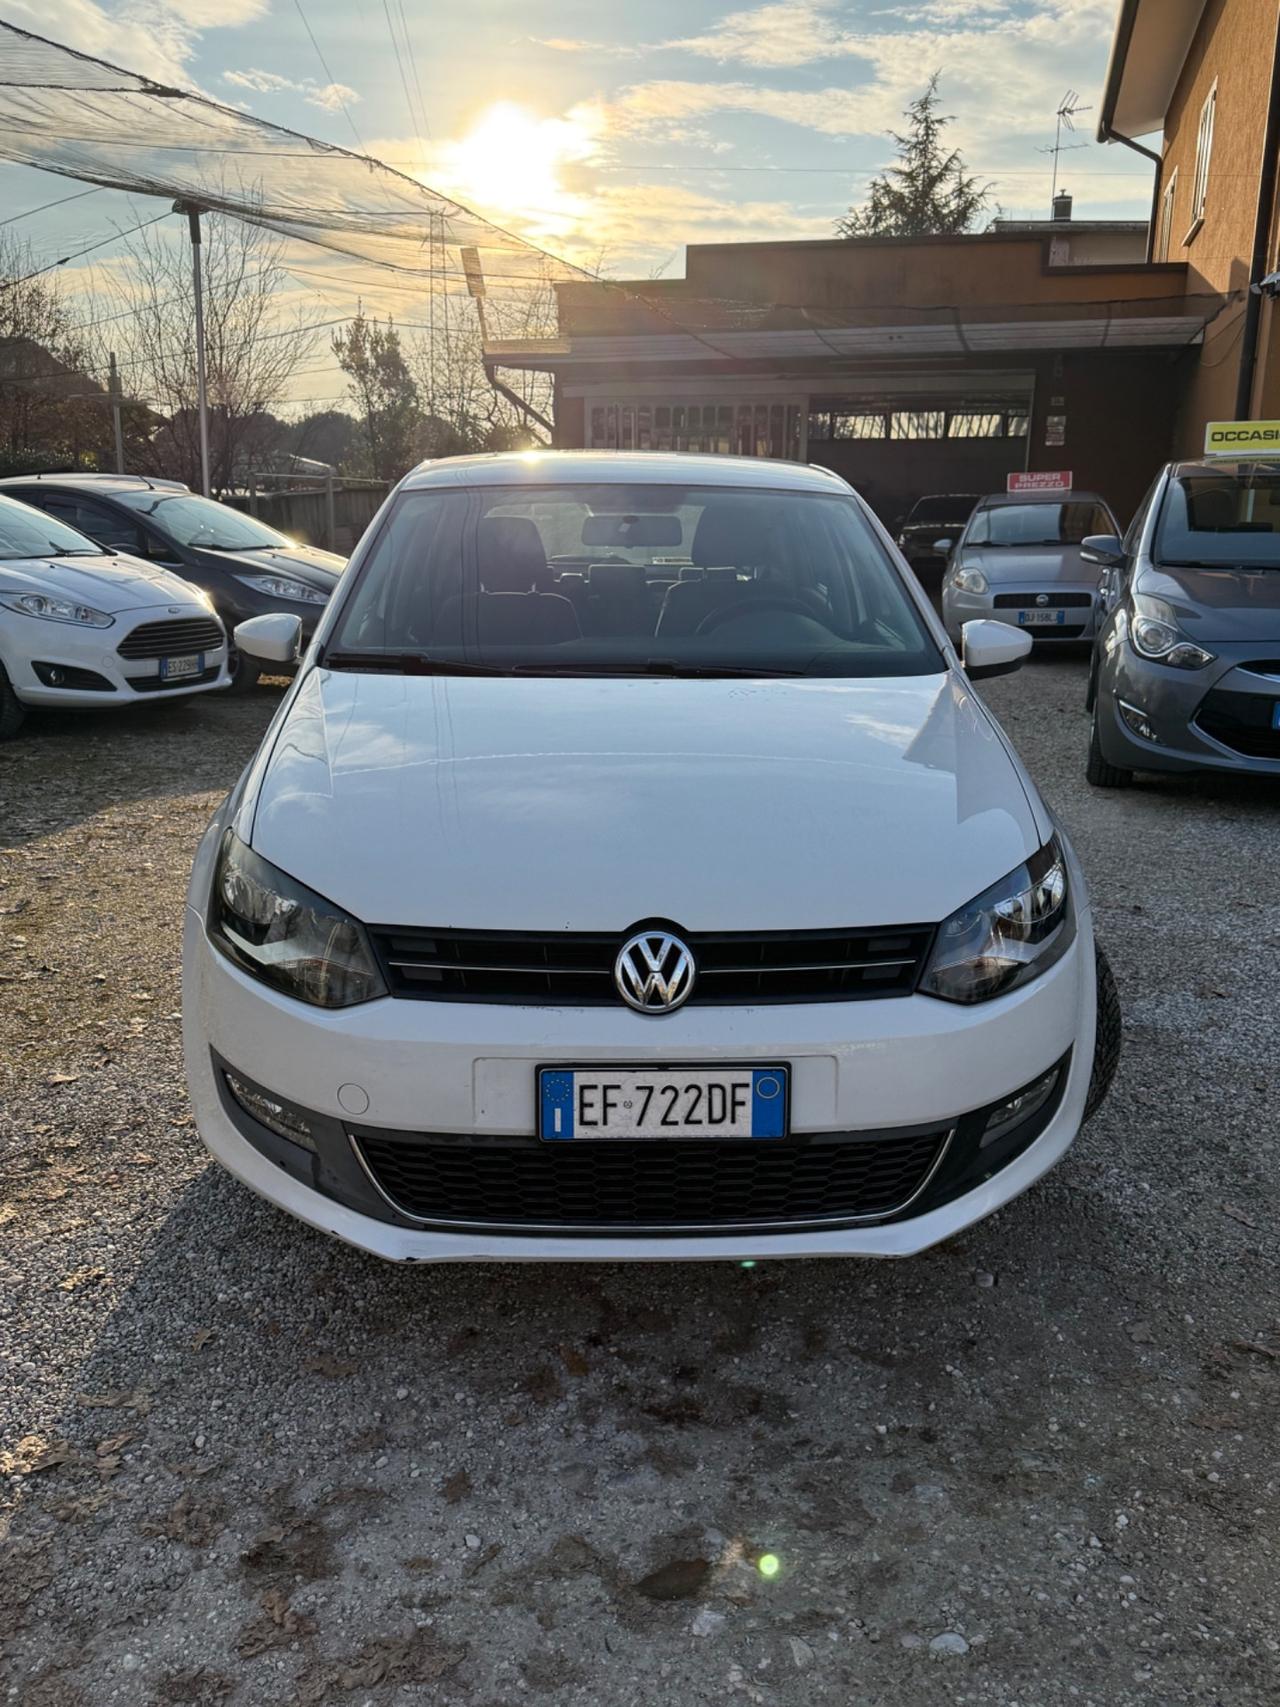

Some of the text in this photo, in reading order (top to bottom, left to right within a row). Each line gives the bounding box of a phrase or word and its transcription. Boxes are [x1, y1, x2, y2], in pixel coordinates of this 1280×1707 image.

[1211, 429, 1280, 442] OCCASI
[1019, 472, 1061, 482] SUPER
[1015, 480, 1065, 489] PREZZO
[617, 933, 693, 1011] VW
[578, 1084, 621, 1127] EF
[635, 1082, 750, 1127] 722DF
